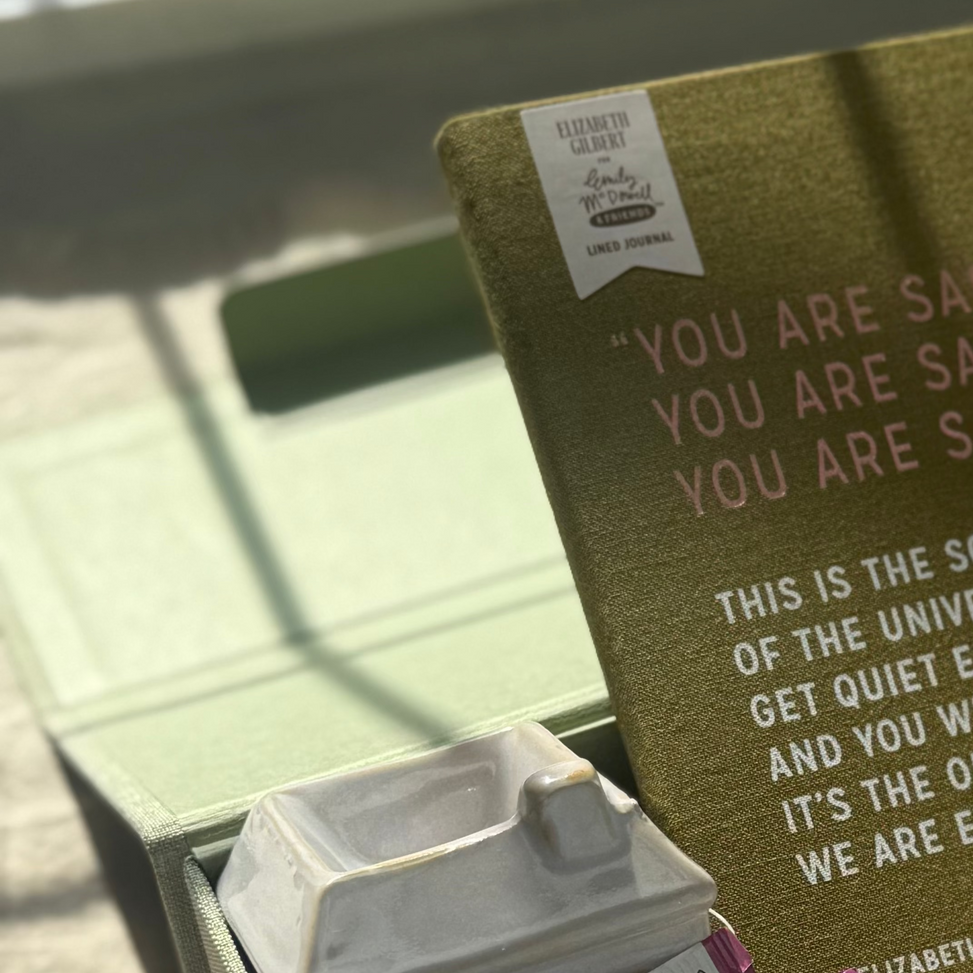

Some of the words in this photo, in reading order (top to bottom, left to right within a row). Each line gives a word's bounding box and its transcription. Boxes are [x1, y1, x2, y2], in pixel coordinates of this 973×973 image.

[556, 111, 630, 139] ELIZABETH
[570, 131, 626, 156] GILBERT
[587, 240, 621, 256] LINED
[624, 231, 675, 250] JOURNAL
[776, 285, 880, 350] ARE
[651, 379, 766, 444] YOU
[795, 353, 898, 419] ARE
[673, 449, 788, 516] YOU
[817, 422, 920, 489] ARE
[715, 576, 803, 625] THIS
[813, 565, 852, 603] IS
[861, 546, 935, 591] THE
[733, 635, 780, 676] OF
[792, 616, 867, 662] THE
[750, 682, 818, 729] GET
[833, 653, 938, 710] QUIET
[769, 734, 842, 782] AND
[852, 712, 926, 758] YOU
[781, 787, 852, 834] IT'S
[860, 765, 935, 813] THE
[795, 840, 860, 886] WE
[873, 818, 945, 869] ARE
